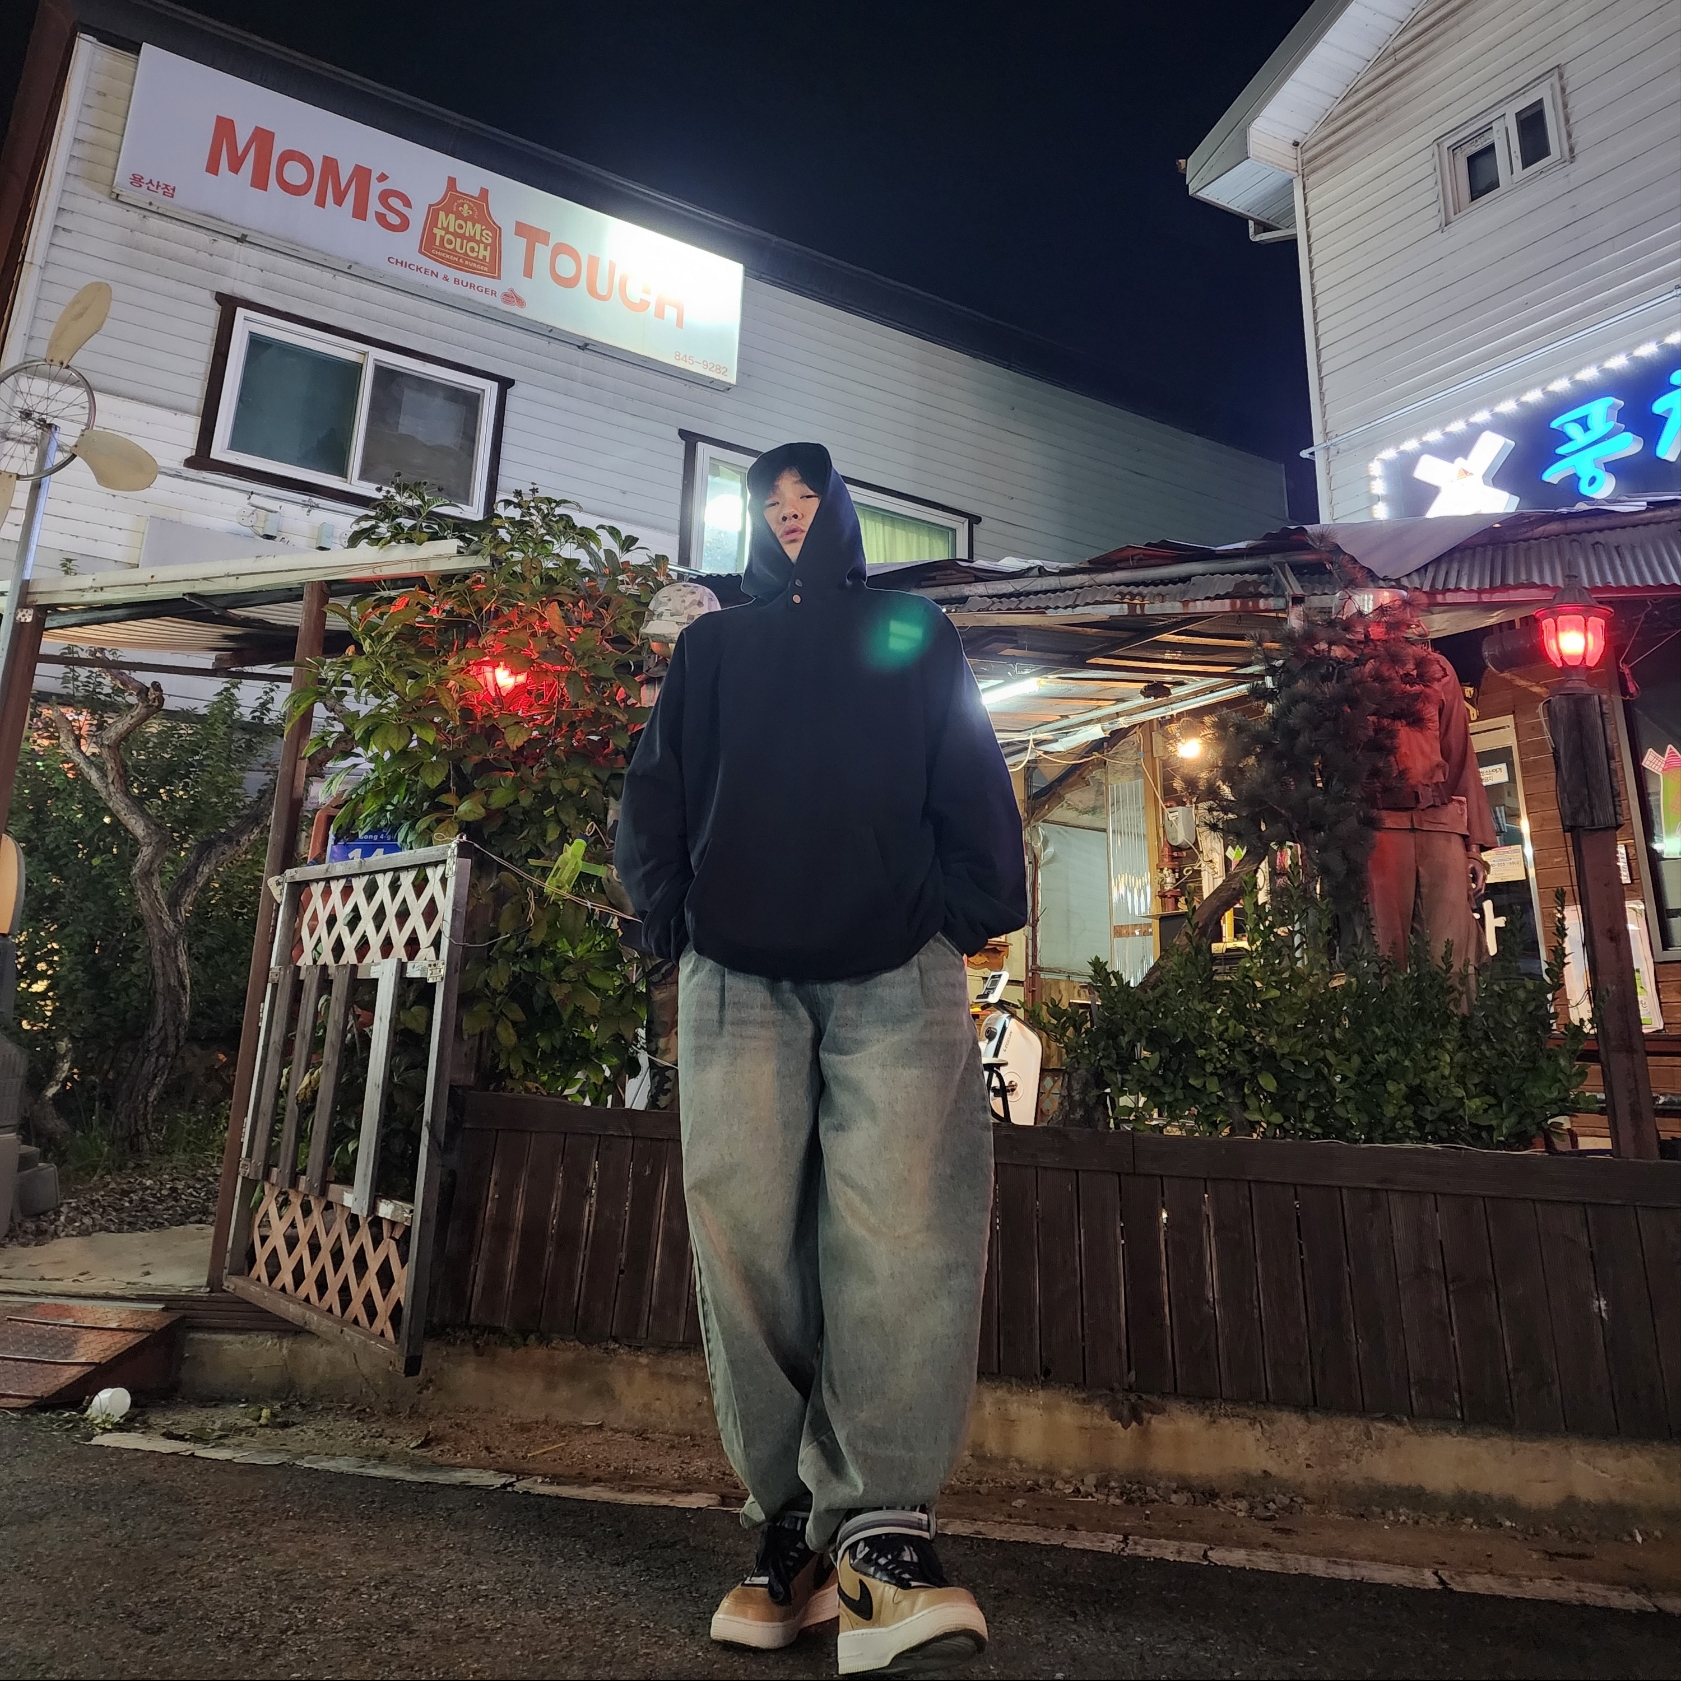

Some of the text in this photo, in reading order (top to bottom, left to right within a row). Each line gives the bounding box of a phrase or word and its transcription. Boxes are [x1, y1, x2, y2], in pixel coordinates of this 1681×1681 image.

[129, 173, 176, 199] 용산점
[433, 227, 491, 263] TOUCH
[431, 249, 459, 262] CHICKEN
[464, 260, 488, 272] BURGER
[387, 256, 498, 298] CHICKEN & BURGER
[674, 350, 728, 377] 845-9282
